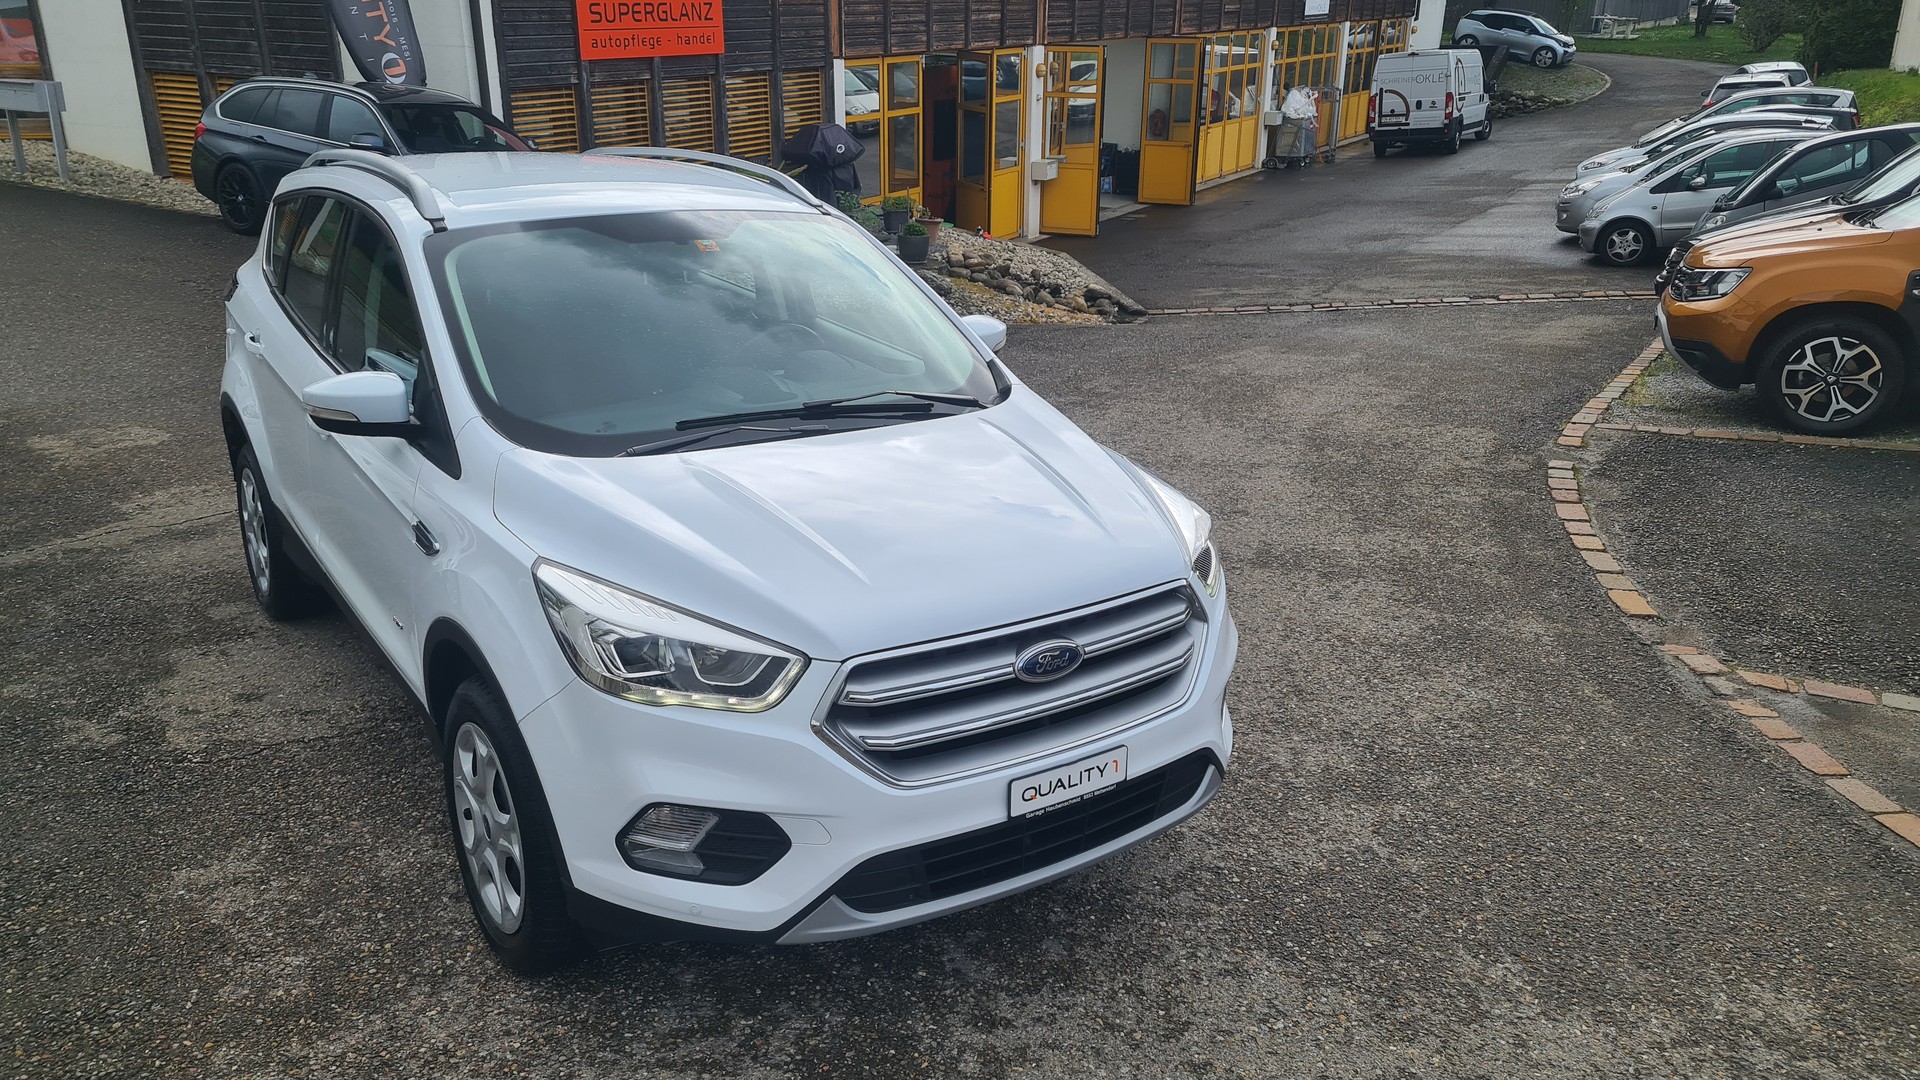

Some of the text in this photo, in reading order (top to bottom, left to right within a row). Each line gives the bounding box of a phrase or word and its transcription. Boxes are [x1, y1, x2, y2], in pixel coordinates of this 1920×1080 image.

[589, 2, 714, 24] SUPERGLANZ
[591, 34, 662, 50] autopflege
[676, 32, 716, 46] handel
[1036, 650, 1070, 674] Ford
[1022, 760, 1118, 802] QUALITY 1
[1025, 809, 1045, 819] Garage
